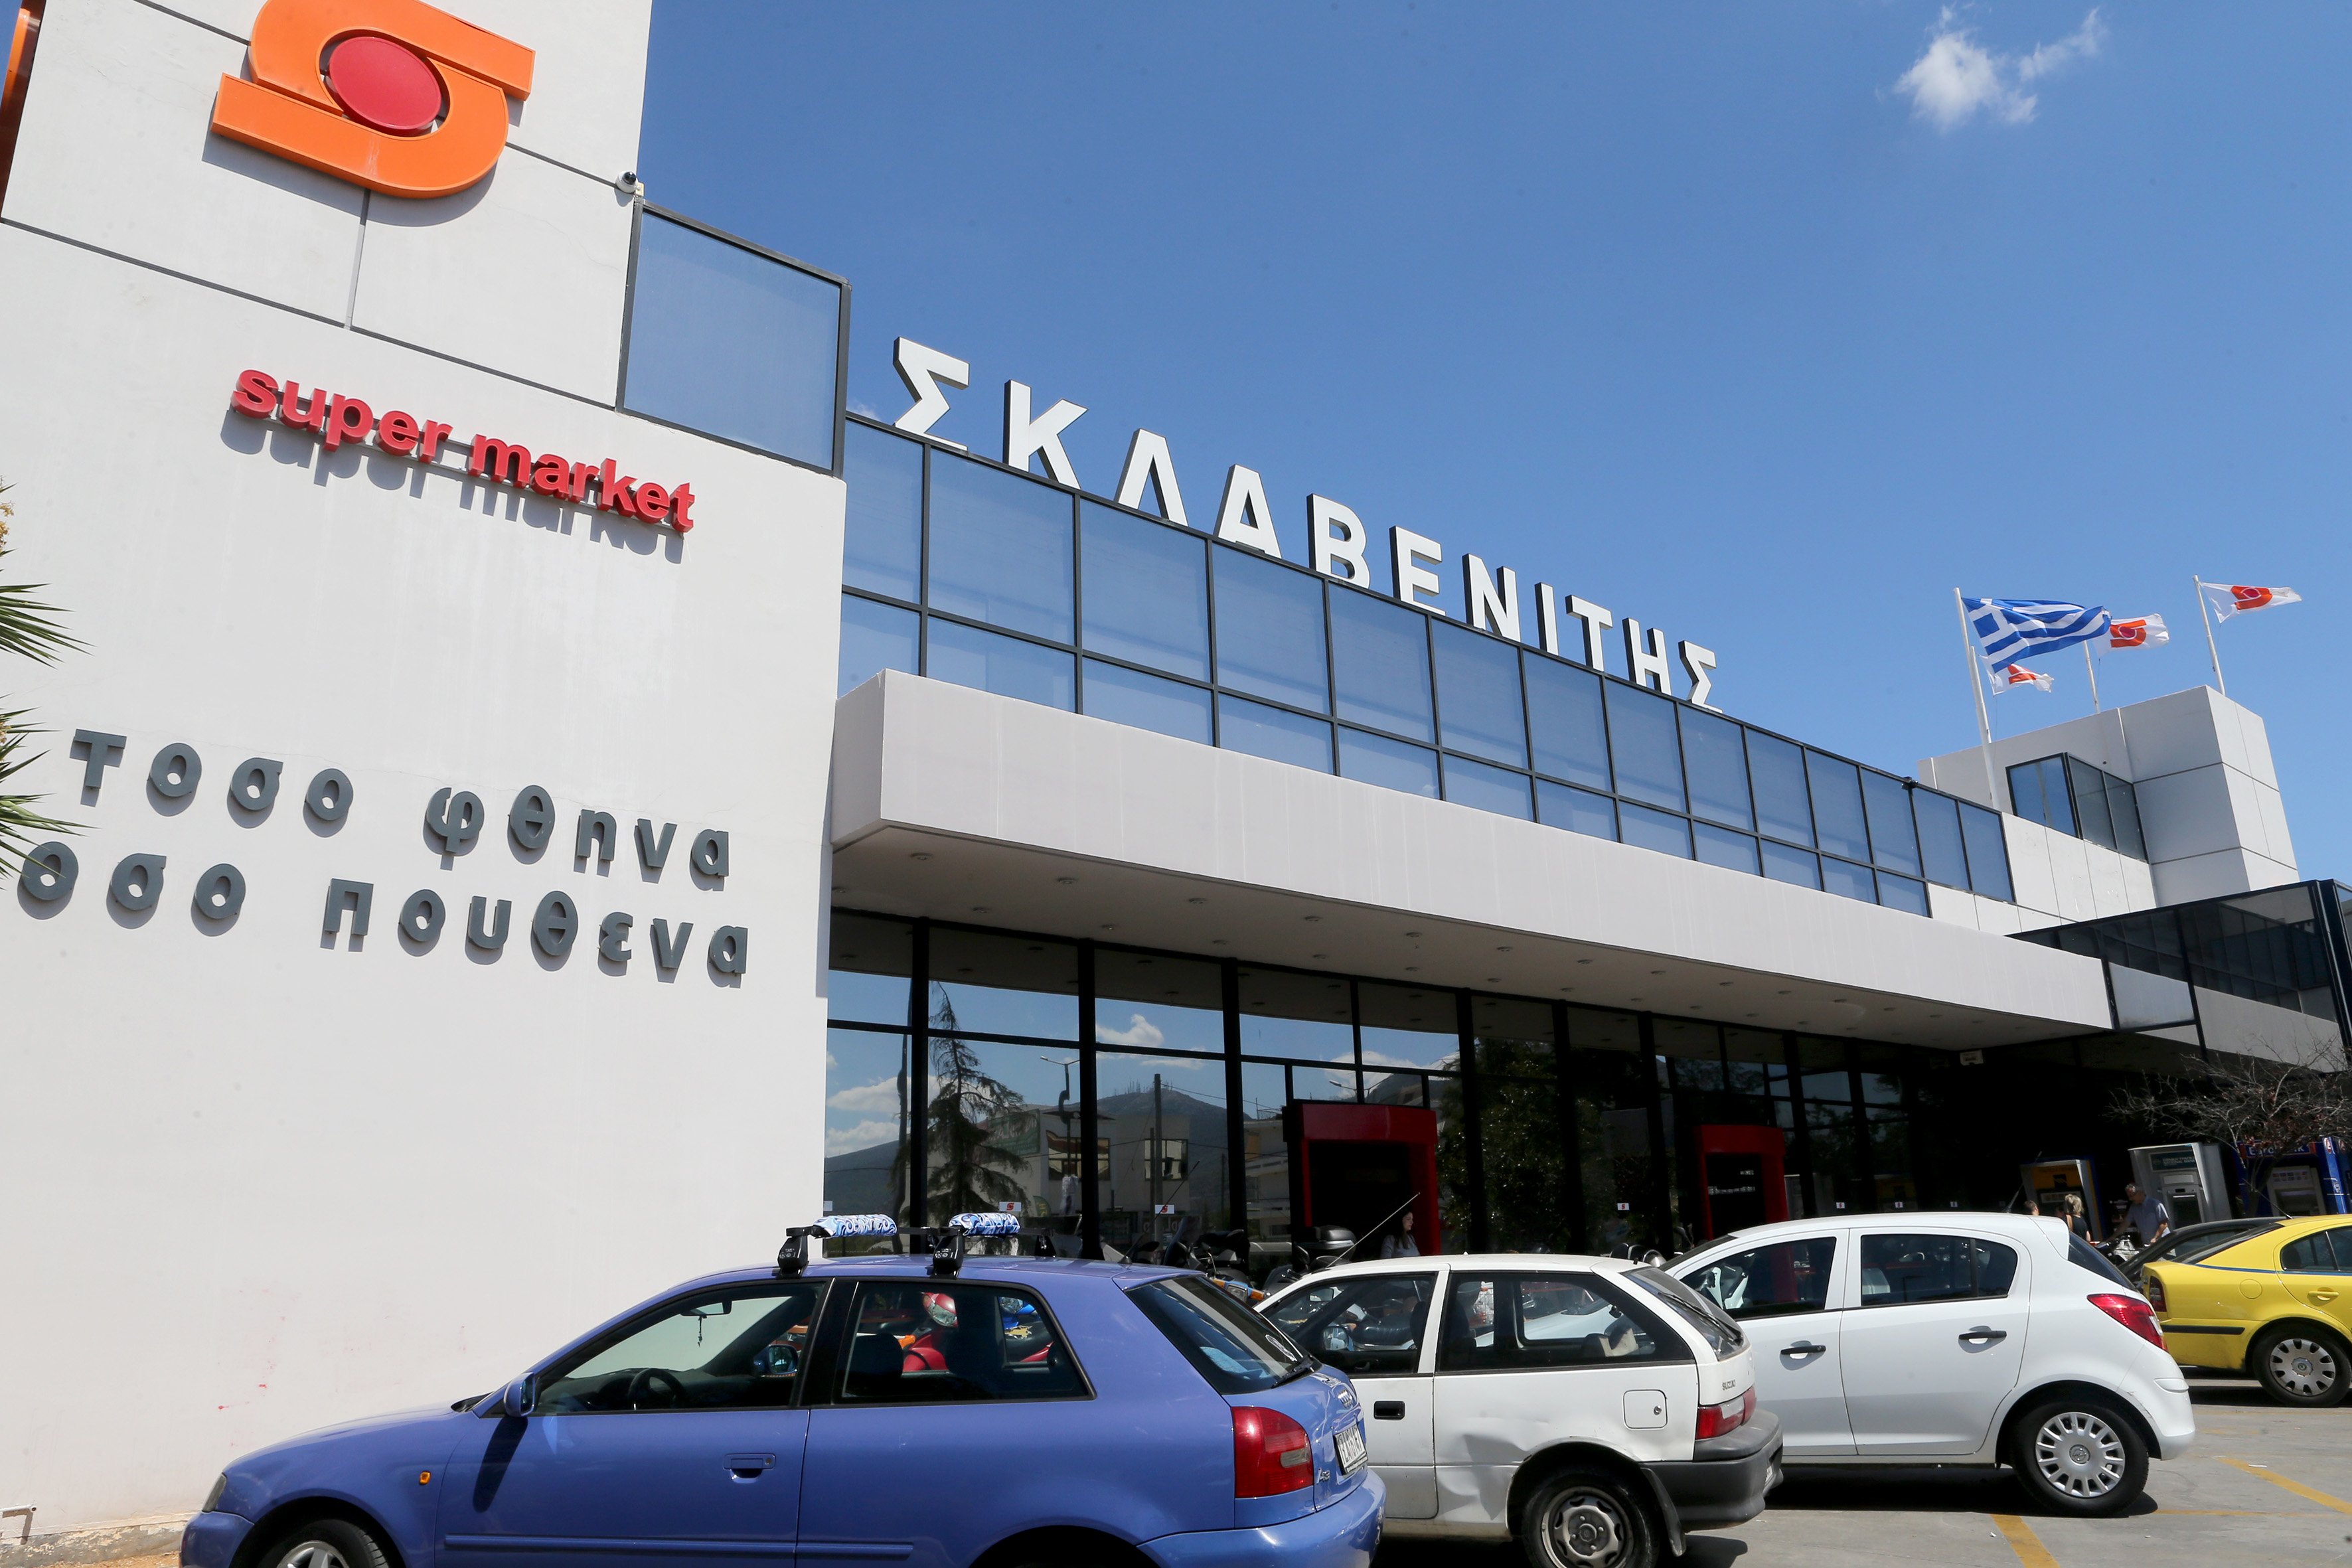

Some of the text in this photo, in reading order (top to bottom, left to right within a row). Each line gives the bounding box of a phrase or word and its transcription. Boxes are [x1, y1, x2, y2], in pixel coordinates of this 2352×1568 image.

[230, 369, 695, 533] super market
[893, 336, 1723, 713] ΣΚΛΑΒΕΝΙΤΗΣ
